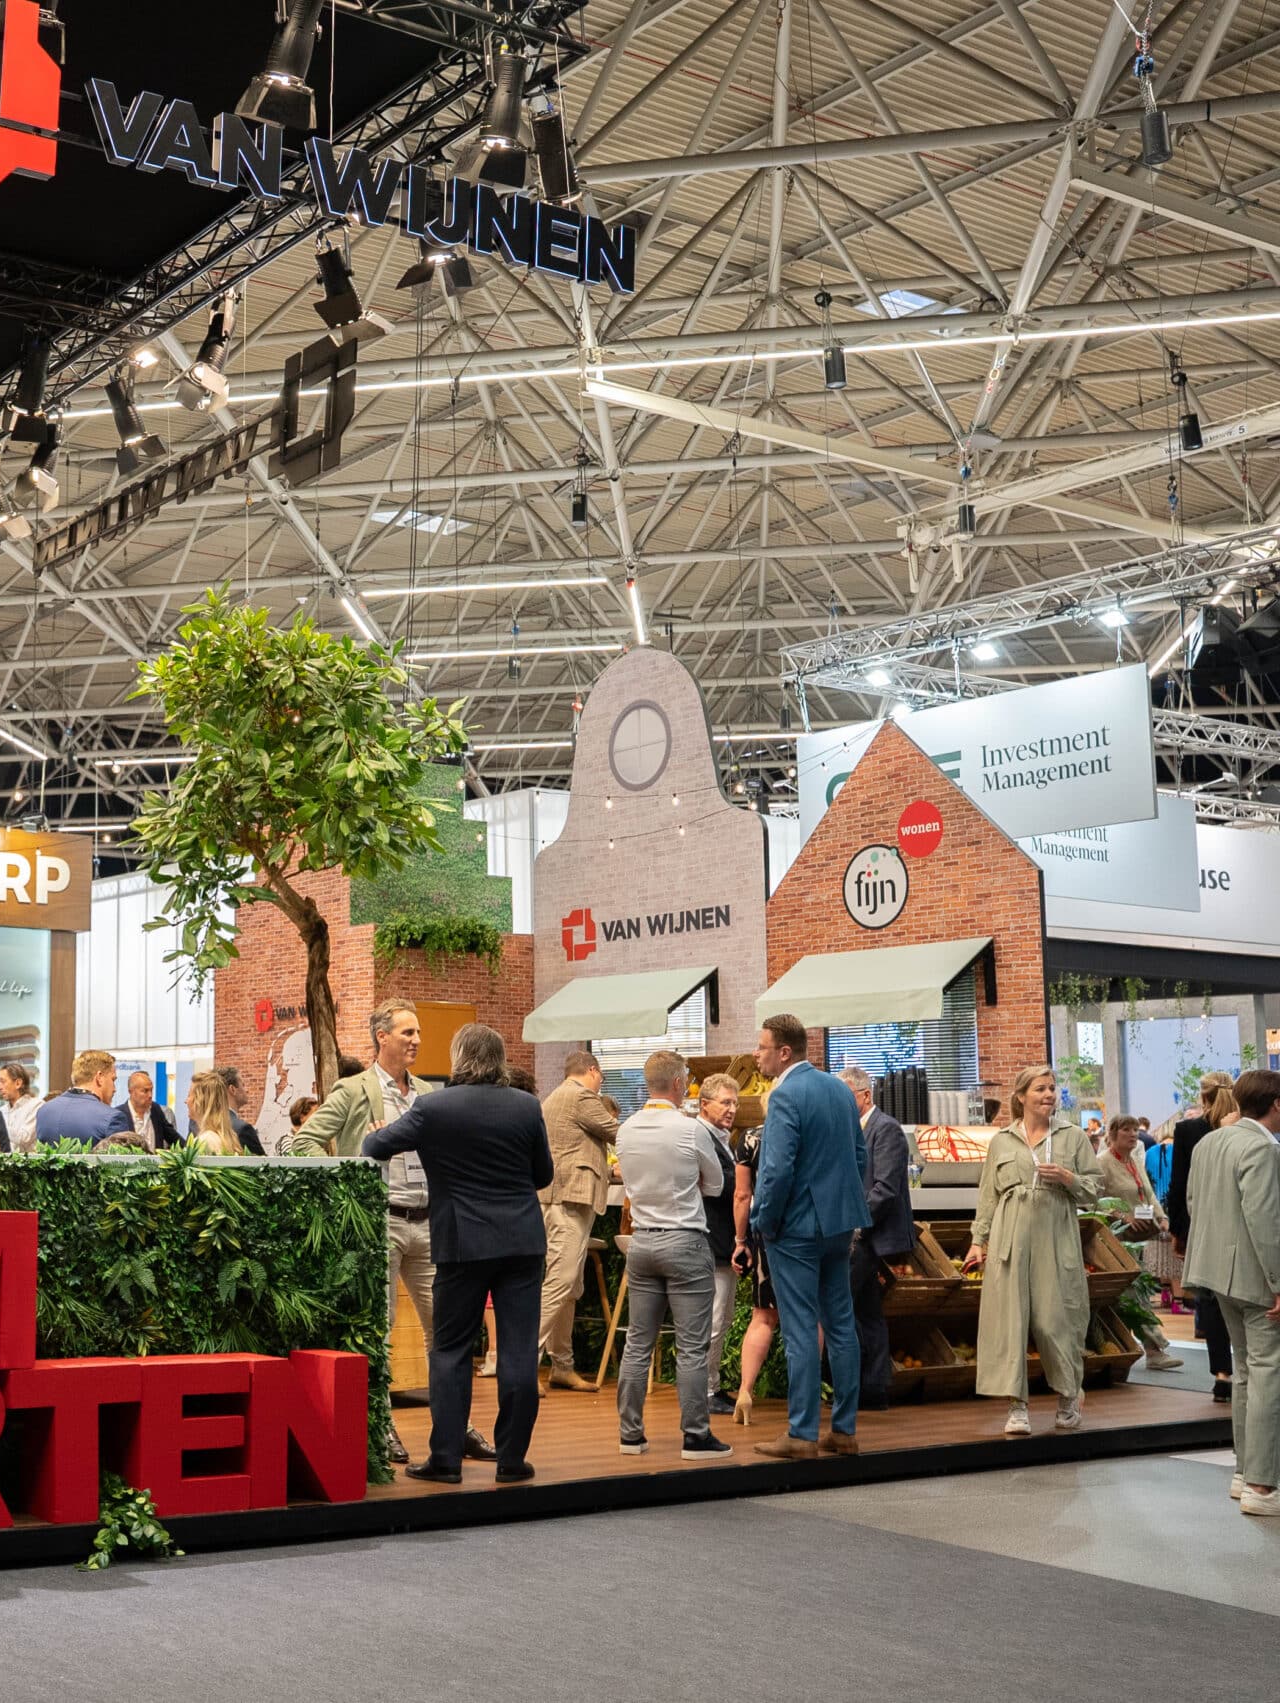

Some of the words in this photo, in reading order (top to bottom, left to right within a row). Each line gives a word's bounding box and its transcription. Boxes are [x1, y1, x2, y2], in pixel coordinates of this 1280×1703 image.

[84, 77, 283, 202] VAN
[304, 136, 637, 295] WIJNEN
[980, 724, 1111, 770] Investment
[980, 753, 1112, 794] Management
[900, 821, 940, 837] wonen
[1031, 835, 1110, 863] Management
[854, 868, 897, 915] fijn
[601, 917, 642, 943] VAN
[648, 904, 731, 938] WIJNEN
[275, 1006, 296, 1020] VAN
